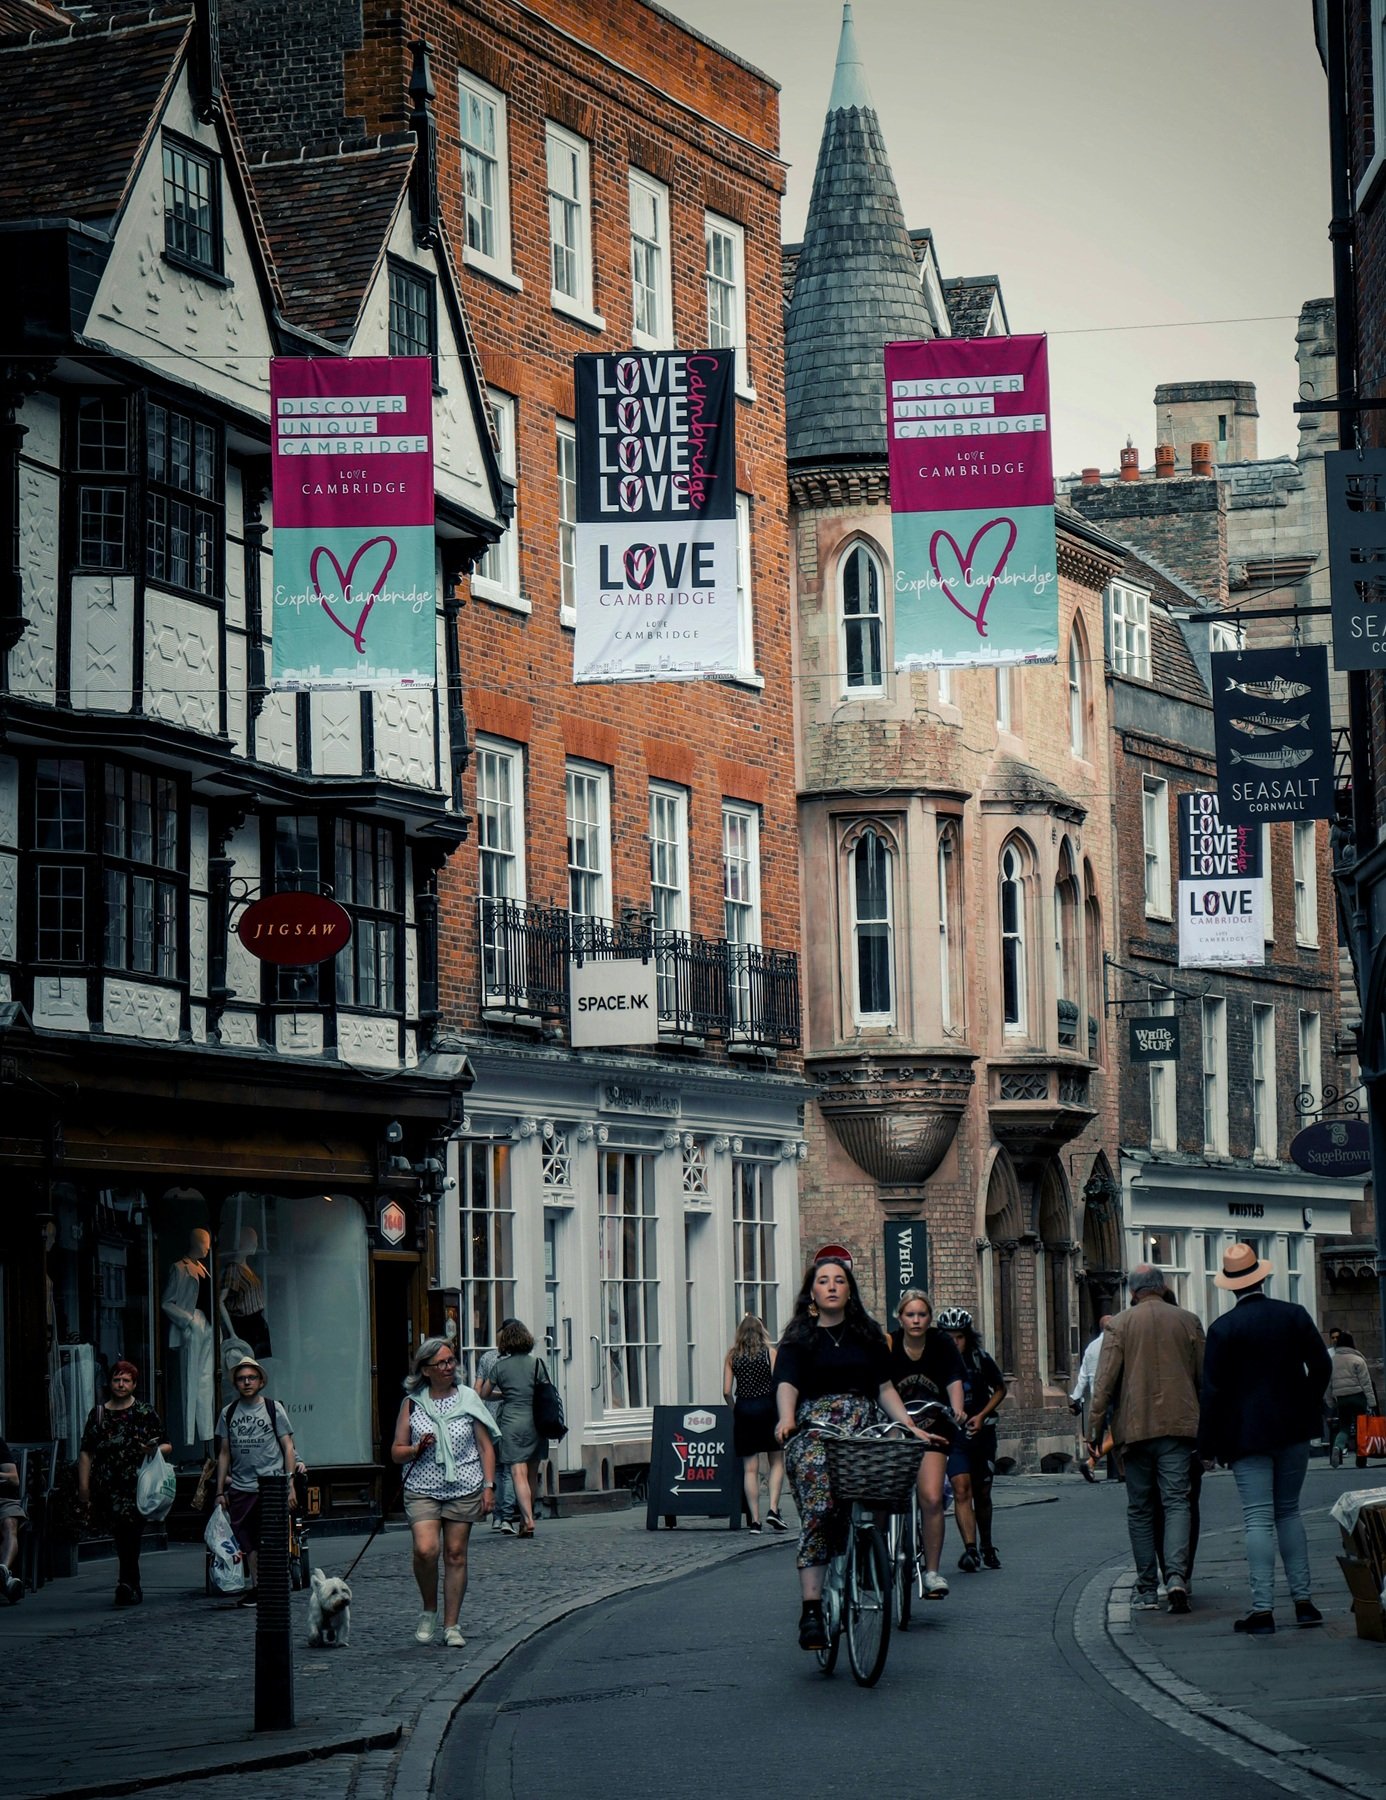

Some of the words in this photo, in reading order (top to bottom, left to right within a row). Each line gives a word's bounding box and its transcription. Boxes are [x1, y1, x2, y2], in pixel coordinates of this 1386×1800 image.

[596, 357, 688, 395] LOVE
[897, 379, 1020, 397] DISCOVER
[282, 400, 403, 414] DISCOVER
[597, 396, 689, 434] LOVE
[897, 401, 990, 417] UNIQUE
[282, 421, 373, 435] UNIQUE
[673, 355, 719, 509] Cambridge
[899, 418, 1043, 438] CAMBRIDGE
[283, 439, 425, 454] CAMBRIDGE
[599, 435, 690, 473] LOVE
[919, 462, 1025, 478] CAMBRIDGE
[301, 482, 406, 495] CAMBRIDGE
[600, 474, 690, 512] LOVE
[600, 542, 716, 591] LOVE
[895, 570, 959, 600] Explore
[964, 565, 1056, 595] Cambridge
[274, 585, 339, 615] Explore
[344, 584, 432, 614] Cambridge
[599, 591, 716, 607] CAMBRIDGE
[615, 630, 699, 640] CAMBRIDGE
[1351, 615, 1386, 638] SE
[1232, 778, 1320, 801] SEASALT
[1249, 801, 1305, 813] CORNWALL
[1190, 835, 1238, 855] LOVE
[1190, 855, 1239, 876] LOVE
[1190, 889, 1253, 916] LOVE
[1190, 916, 1253, 925] CAMBRIDGE
[253, 923, 336, 939] JIGSAW
[578, 993, 649, 1011] SPACE.NK
[1307, 1149, 1371, 1166] SageBrown
[1228, 1203, 1264, 1218] WHISTLES
[229, 1415, 273, 1433] OMPTON
[688, 1442, 725, 1455] COCK
[687, 1455, 719, 1467] TAIL
[687, 1468, 715, 1481] BAR
